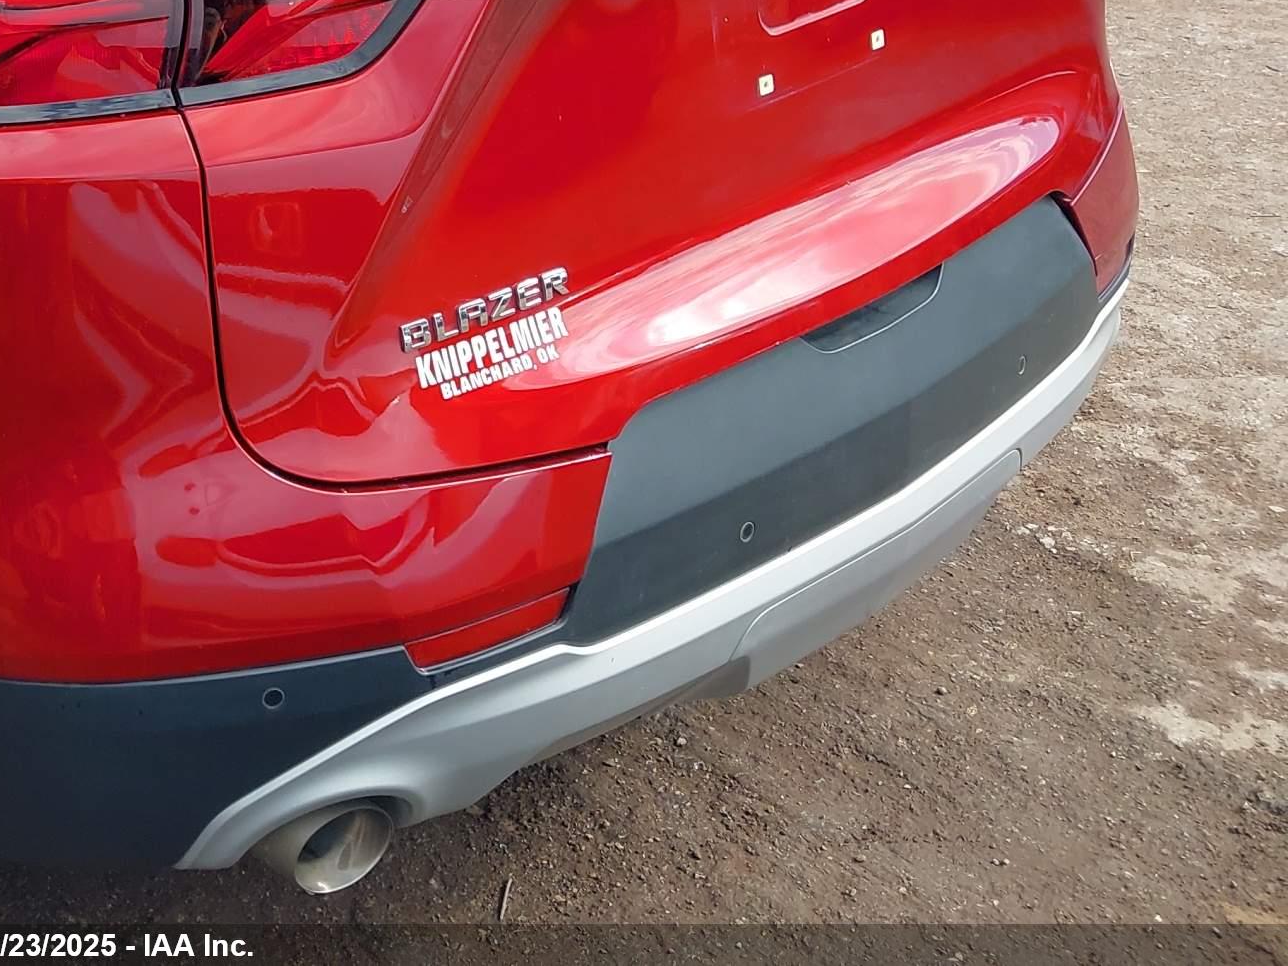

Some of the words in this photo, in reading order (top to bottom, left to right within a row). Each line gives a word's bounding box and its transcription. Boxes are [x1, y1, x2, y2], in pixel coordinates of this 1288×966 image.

[399, 266, 570, 353] BLAZER
[415, 305, 569, 389] KNIPPELMIER
[440, 354, 538, 400] BLANCHARD,
[536, 343, 560, 364] OK
